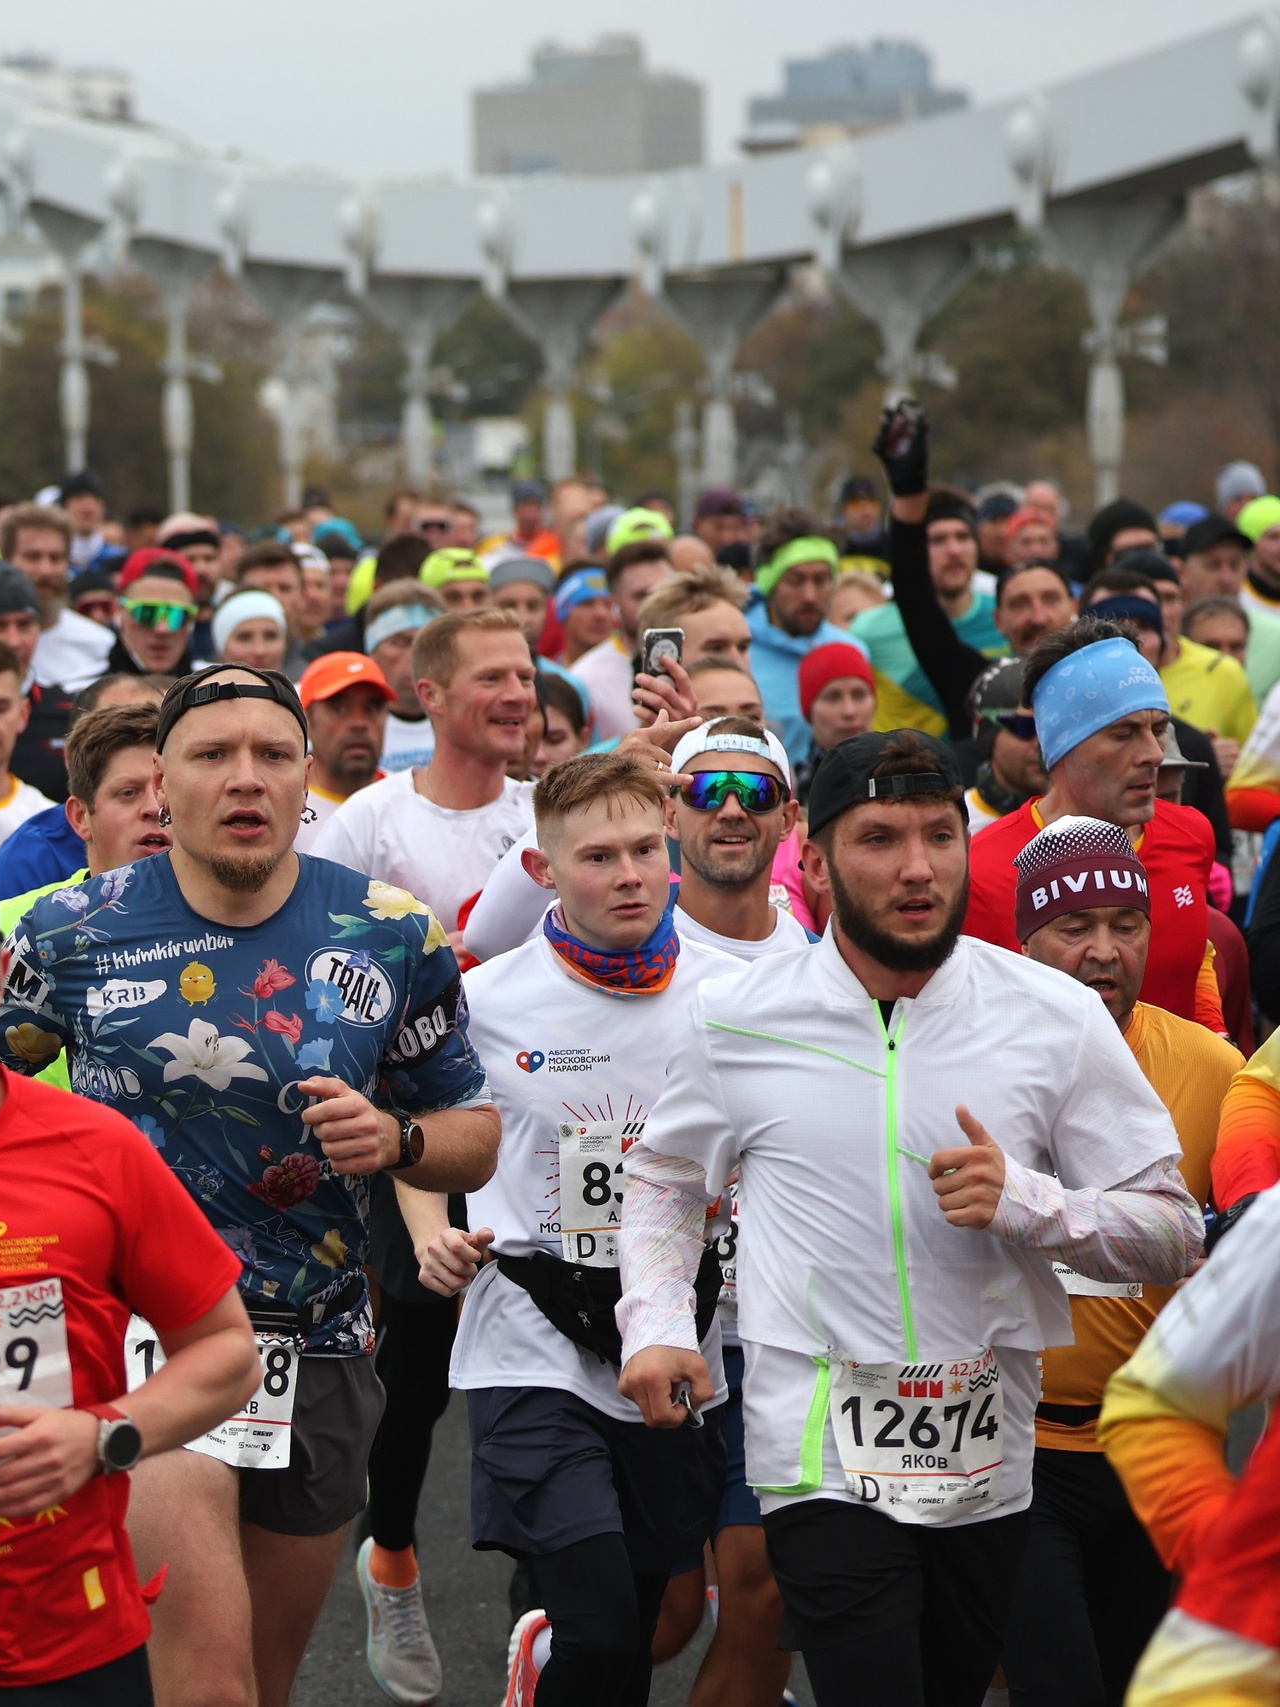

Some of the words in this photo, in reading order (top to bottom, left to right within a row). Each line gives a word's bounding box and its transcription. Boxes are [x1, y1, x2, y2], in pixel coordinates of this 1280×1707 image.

[1031, 870, 1148, 911] BIVIUM
[328, 956, 381, 1022] TRAIL
[548, 1055, 611, 1064] МОСКОВСКИЙ
[548, 1064, 593, 1073] МАРАФОН
[577, 1233, 597, 1259] D
[949, 1361, 981, 1377] 42,2
[841, 1393, 999, 1453] 12674
[206, 1434, 226, 1445] FONBET
[901, 1454, 948, 1469] ЯКОВ
[859, 1475, 880, 1502] D
